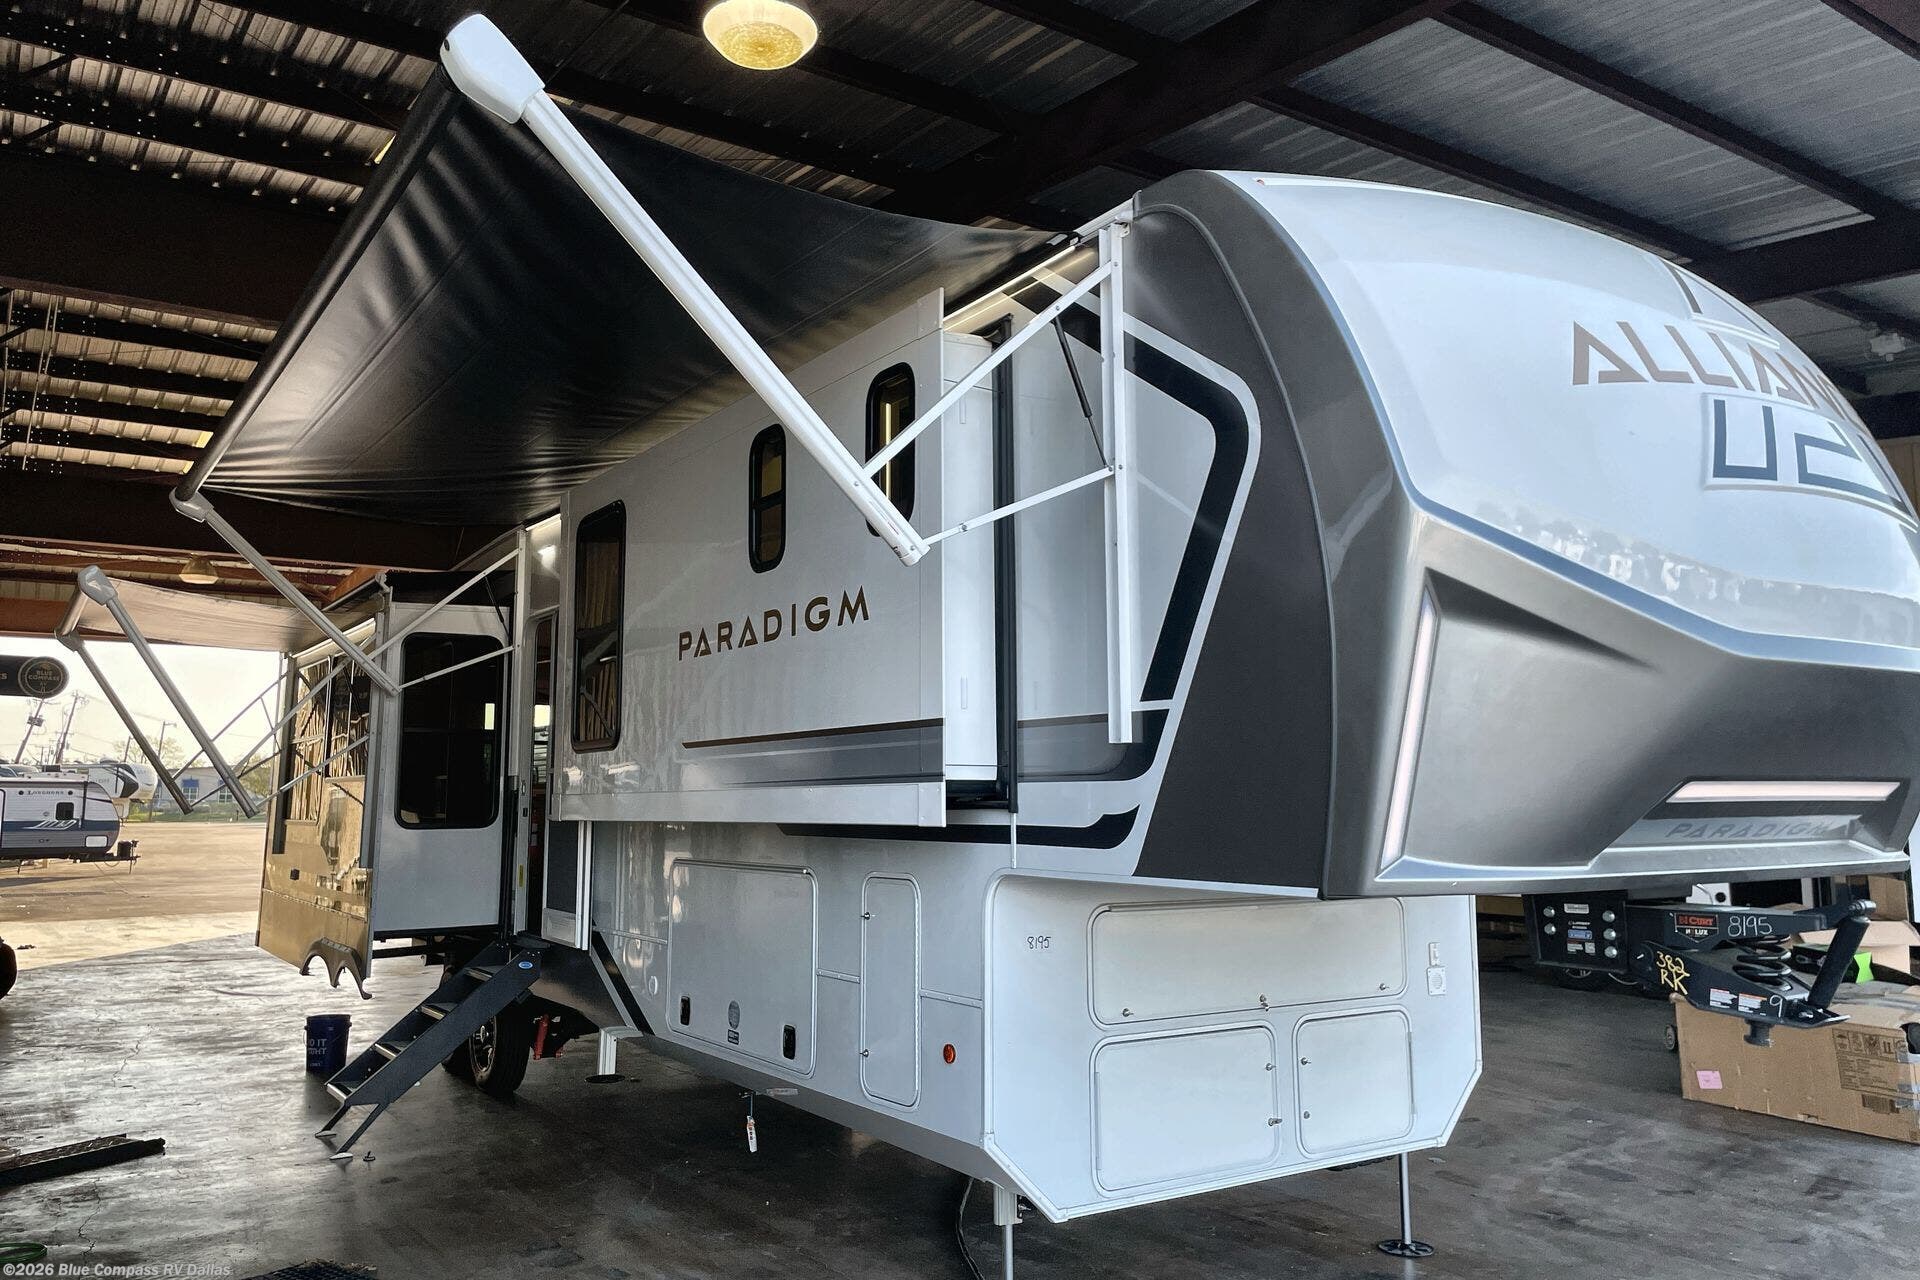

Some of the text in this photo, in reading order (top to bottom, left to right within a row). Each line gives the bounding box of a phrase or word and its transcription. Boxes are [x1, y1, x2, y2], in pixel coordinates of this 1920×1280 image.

[678, 585, 870, 662] PARADIGM
[1727, 915, 1773, 937] 8195
[1026, 935, 1052, 951] 8195
[1656, 951, 1690, 977] 382
[1660, 966, 1689, 996] RK
[317, 1038, 327, 1046] IT
